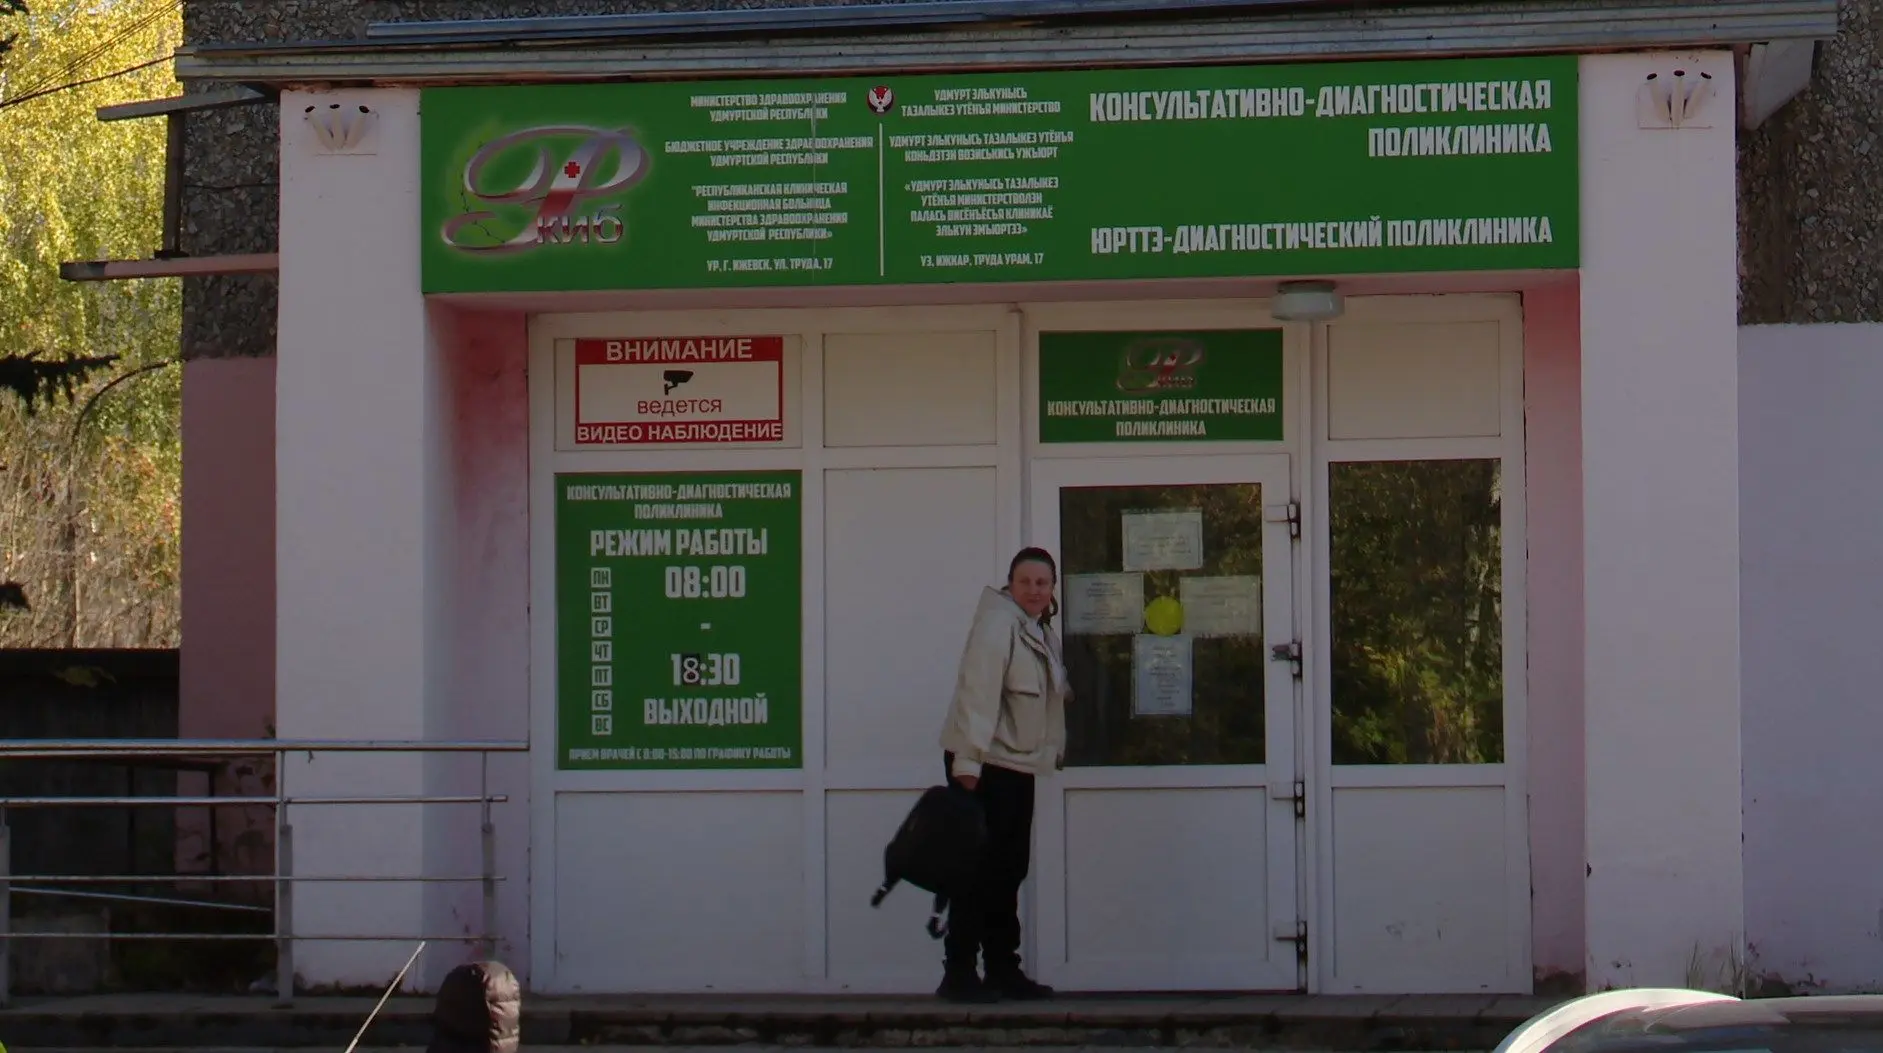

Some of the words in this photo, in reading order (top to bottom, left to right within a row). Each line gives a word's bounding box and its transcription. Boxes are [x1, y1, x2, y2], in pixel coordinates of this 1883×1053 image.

[691, 95, 757, 107] МИНИСТЕРСТВО
[759, 92, 846, 104] ЗДРАВООХРАНЕНИЯ
[934, 88, 971, 101] УДМУРТ
[972, 87, 1027, 99] ЭЛЬКУНЫСЬ
[1090, 80, 1551, 122] КОНСУЛЬТАТИВНО-ДИАГНОСТИЧЕСКАЯ
[710, 108, 768, 122] УДМУРТСКОЙ
[770, 108, 827, 120] РЕСПУБЛИКИ
[901, 105, 955, 116] ТАЗАЛЫКЕЗ
[993, 102, 1060, 114] МИНИСТЕРСТВО
[665, 141, 724, 153] БЮДЖЕТНОЕ
[724, 139, 783, 151] УЧРЕЖДЕНИЕ
[785, 137, 873, 149] ЗДРАВООХРАНЕНИЯ
[889, 136, 926, 148] УДМУРТ
[927, 134, 982, 146] ЭЛЬКУНЫСЬ
[984, 132, 1037, 144] ТАЗАЛЫКЕЗ
[1369, 123, 1551, 157] ПОЛИКЛИНИКА
[710, 153, 768, 167] УДМУРТСКОЙ
[770, 153, 828, 165] РЕСПУБЛИКИ
[784, 182, 847, 195] КЛИНИЧЕСКАЯ
[948, 179, 1004, 190] ЭЛЬКУНЫСЬ
[1005, 177, 1058, 189] ТАЗАЛЫКЕЗ
[708, 199, 781, 211] ИНФЕКЦИОННАЯ
[782, 198, 831, 210] БОЛЬНИЦА
[692, 215, 758, 227] МИНИСТЕРСТВА
[759, 212, 848, 225] ЗДРАВООХРАНЕНИЯ
[707, 227, 765, 241] УДМУРТСКОЙ
[936, 224, 972, 236] ЭЛЬКУН
[1091, 215, 1382, 254] ЮРТТЭ-ДИАГНОСТИЧЕСКИЙ
[1387, 216, 1552, 247] ПОЛИКЛИНИКА
[823, 257, 833, 269] 17
[973, 254, 1003, 266] ТРУДА
[1034, 253, 1044, 264] 17
[606, 338, 752, 361] ВНИМАНИЕ
[637, 399, 722, 416] ведется
[1048, 398, 1276, 416] КОНСУЛЬТАТИВНО-ДИАГНОСТИЧЕСКАЯ
[577, 425, 643, 443] ВИДЕО
[648, 423, 782, 441] НАБЛЮДЕНИЕ
[1116, 420, 1206, 437] ПОЛИКЛИНИКА
[567, 483, 791, 500] КОНСУЛЬТАТИВНО-ДИАГНОСТИЧЕСКАЯ
[634, 503, 723, 519] ПОЛИКЛИНИКА
[590, 529, 671, 556] РЕЖИМ
[676, 528, 768, 555] РАБОТЫ
[594, 570, 609, 584] ПН
[665, 566, 746, 598] 08:00
[594, 594, 609, 610] ВТ
[594, 619, 609, 633] СР
[594, 643, 609, 658] ЧТ
[594, 668, 609, 683] ПТ
[670, 653, 740, 686] 18:30
[594, 692, 609, 707] СБ
[644, 692, 768, 726] ВЫХОДНОЙ
[594, 717, 609, 731] ВС
[600, 746, 635, 760] ВРАЧЕЙ
[693, 748, 706, 760] ПО
[753, 747, 790, 759] РАБОТЫ
